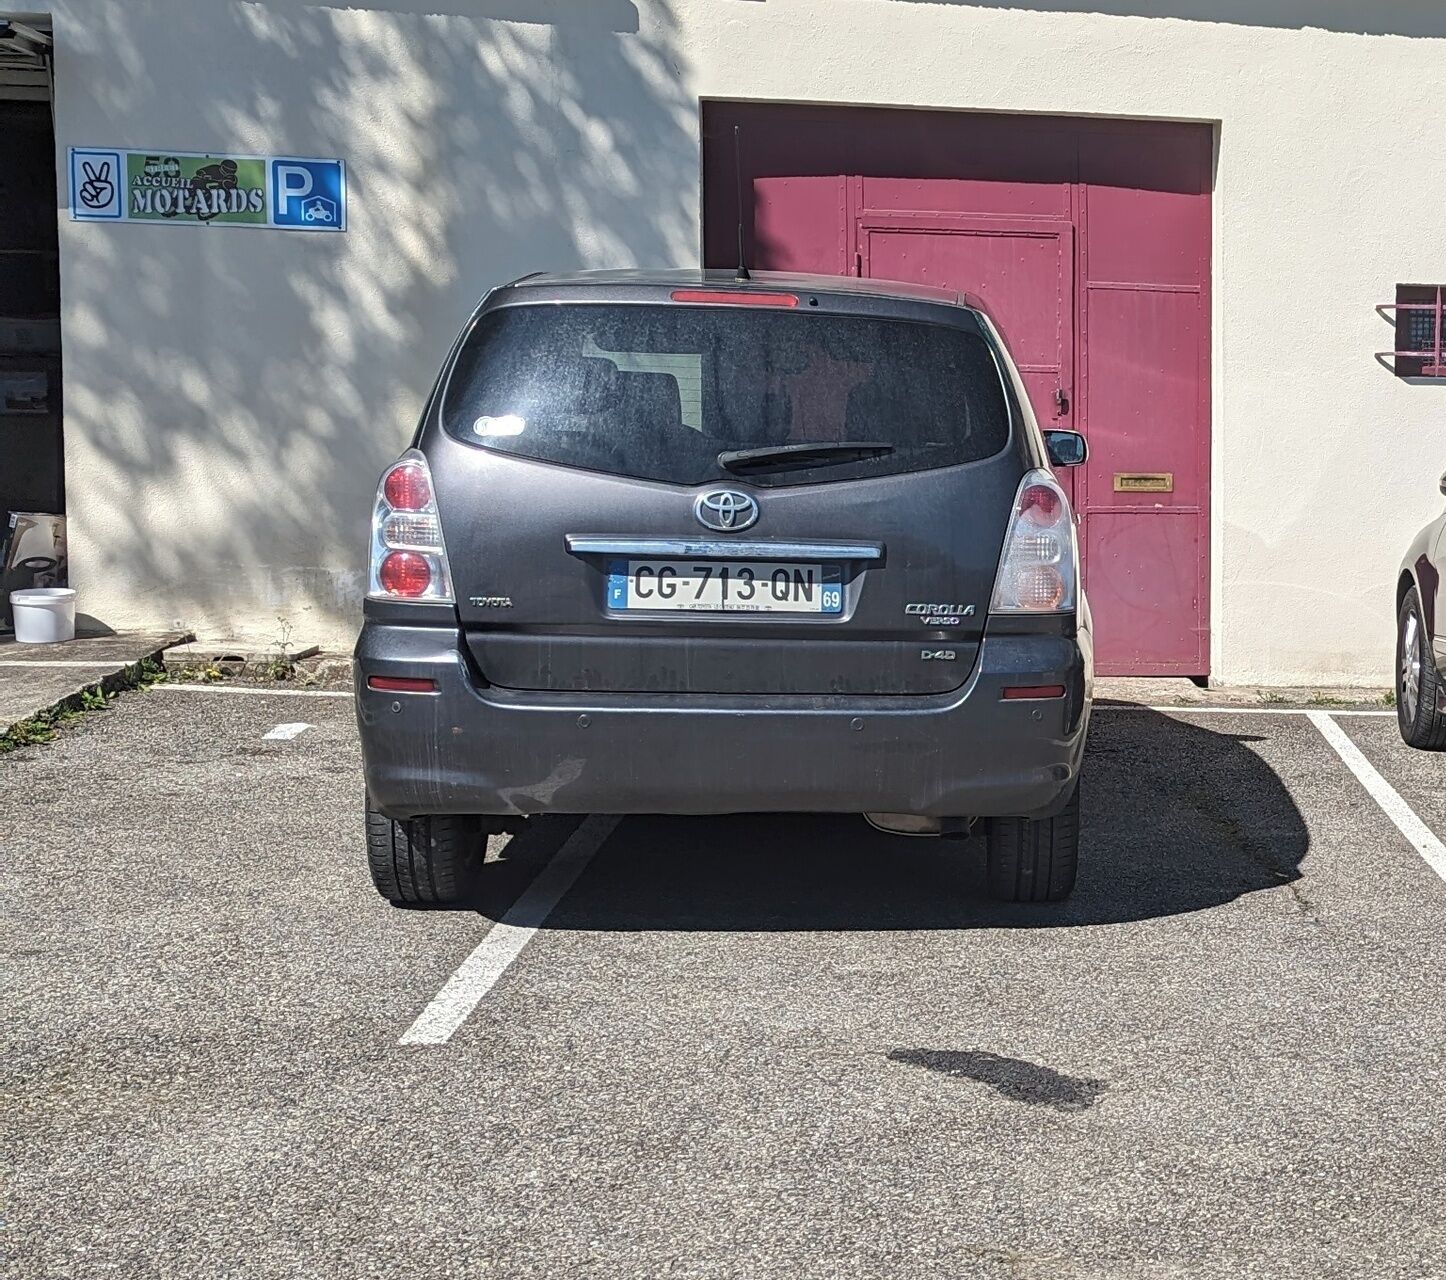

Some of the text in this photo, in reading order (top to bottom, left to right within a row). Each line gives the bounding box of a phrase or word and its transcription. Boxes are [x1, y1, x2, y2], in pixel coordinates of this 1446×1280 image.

[132, 175, 194, 189] ACCUEIL
[277, 164, 314, 215] P
[132, 187, 264, 214] MOTARDS
[613, 566, 841, 608] F CG-713-QN 69
[469, 596, 513, 607] TOYOTA
[904, 603, 976, 616] COROLLA
[920, 616, 960, 625] VERSO
[921, 650, 956, 660] D-4D
